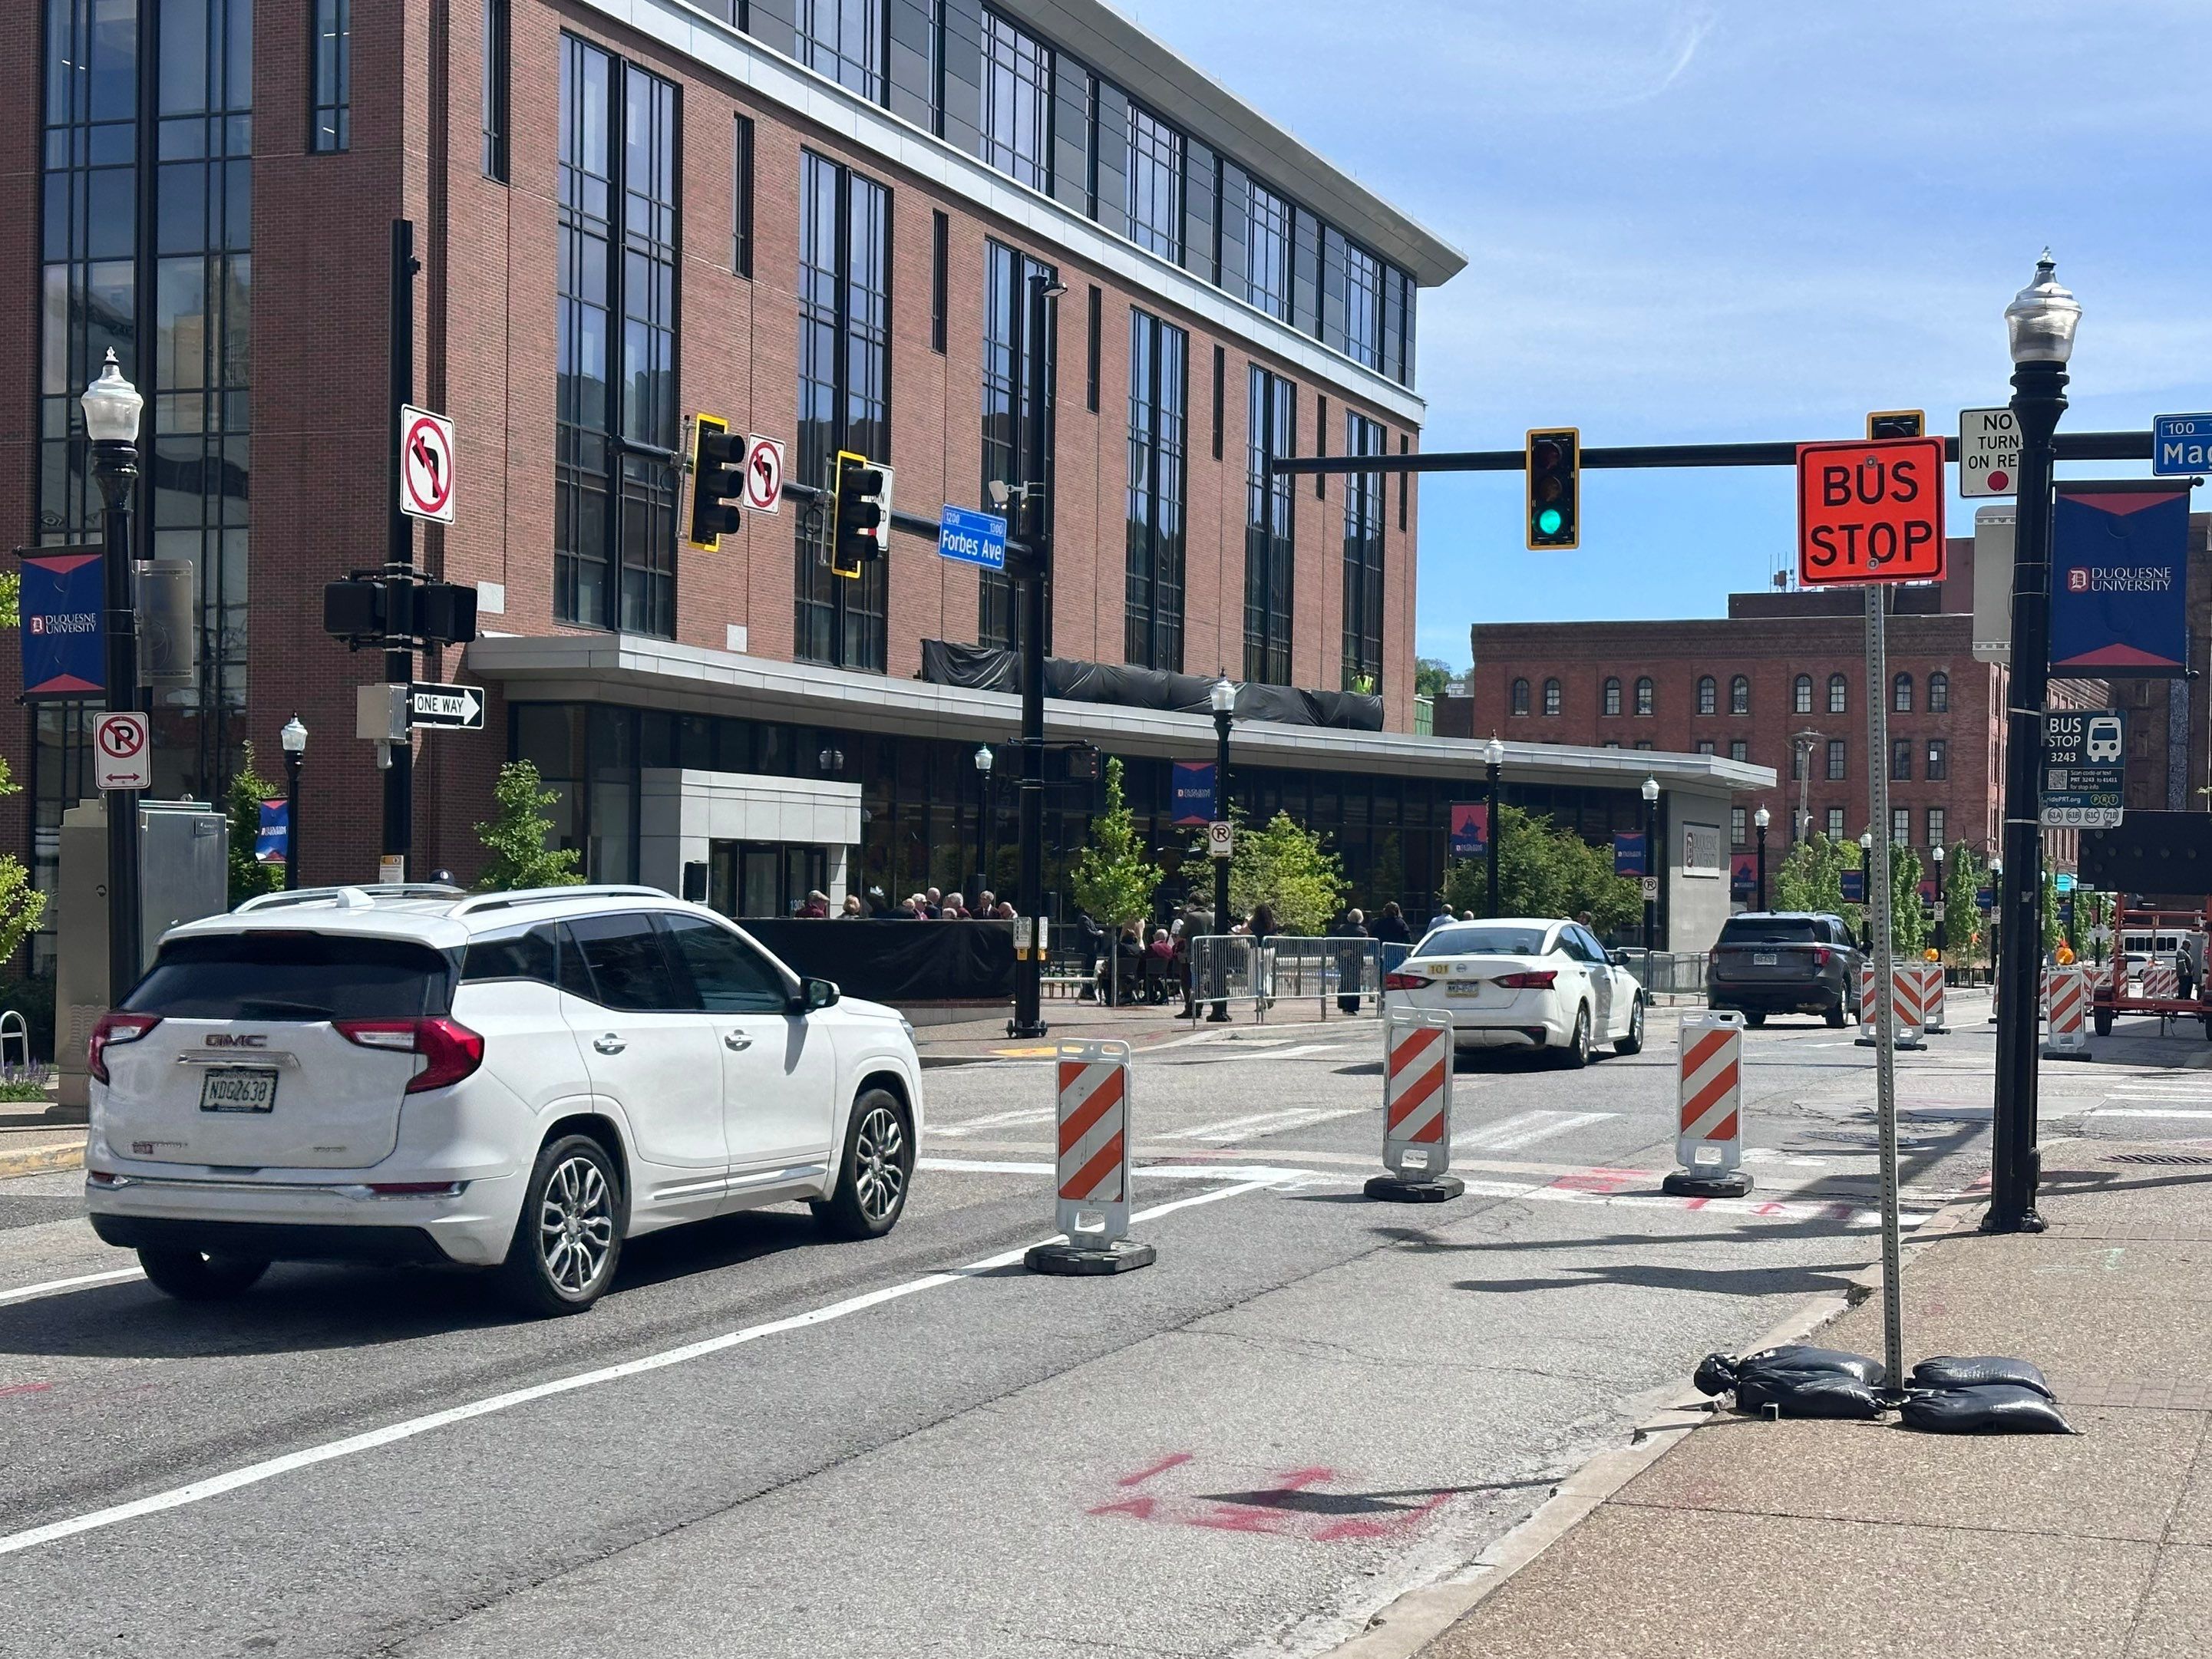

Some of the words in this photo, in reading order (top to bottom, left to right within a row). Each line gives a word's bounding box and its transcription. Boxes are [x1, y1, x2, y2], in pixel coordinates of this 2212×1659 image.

[1983, 414, 2012, 430] NO
[2168, 422, 2194, 435] 100
[1977, 434, 2019, 450] TURN
[1968, 454, 1989, 470] ON
[1997, 454, 2018, 468] RE
[1823, 460, 1918, 506] BUS
[942, 529, 979, 556] Forbes
[982, 539, 1002, 561] Ave
[1810, 520, 1933, 567] STOP
[2091, 567, 2171, 581] DUQUESNE
[2091, 579, 2171, 592] UNIVERSITY
[45, 613, 96, 625] DUQUESNE
[46, 622, 96, 635] UNIVERSITY
[418, 695, 438, 712] ONE
[442, 698, 464, 714] WAY
[2049, 717, 2082, 733] BUS
[2049, 735, 2082, 747] STOP
[2050, 752, 2076, 763] 3243
[1430, 965, 1448, 974] 101
[205, 1034, 268, 1047] GMC
